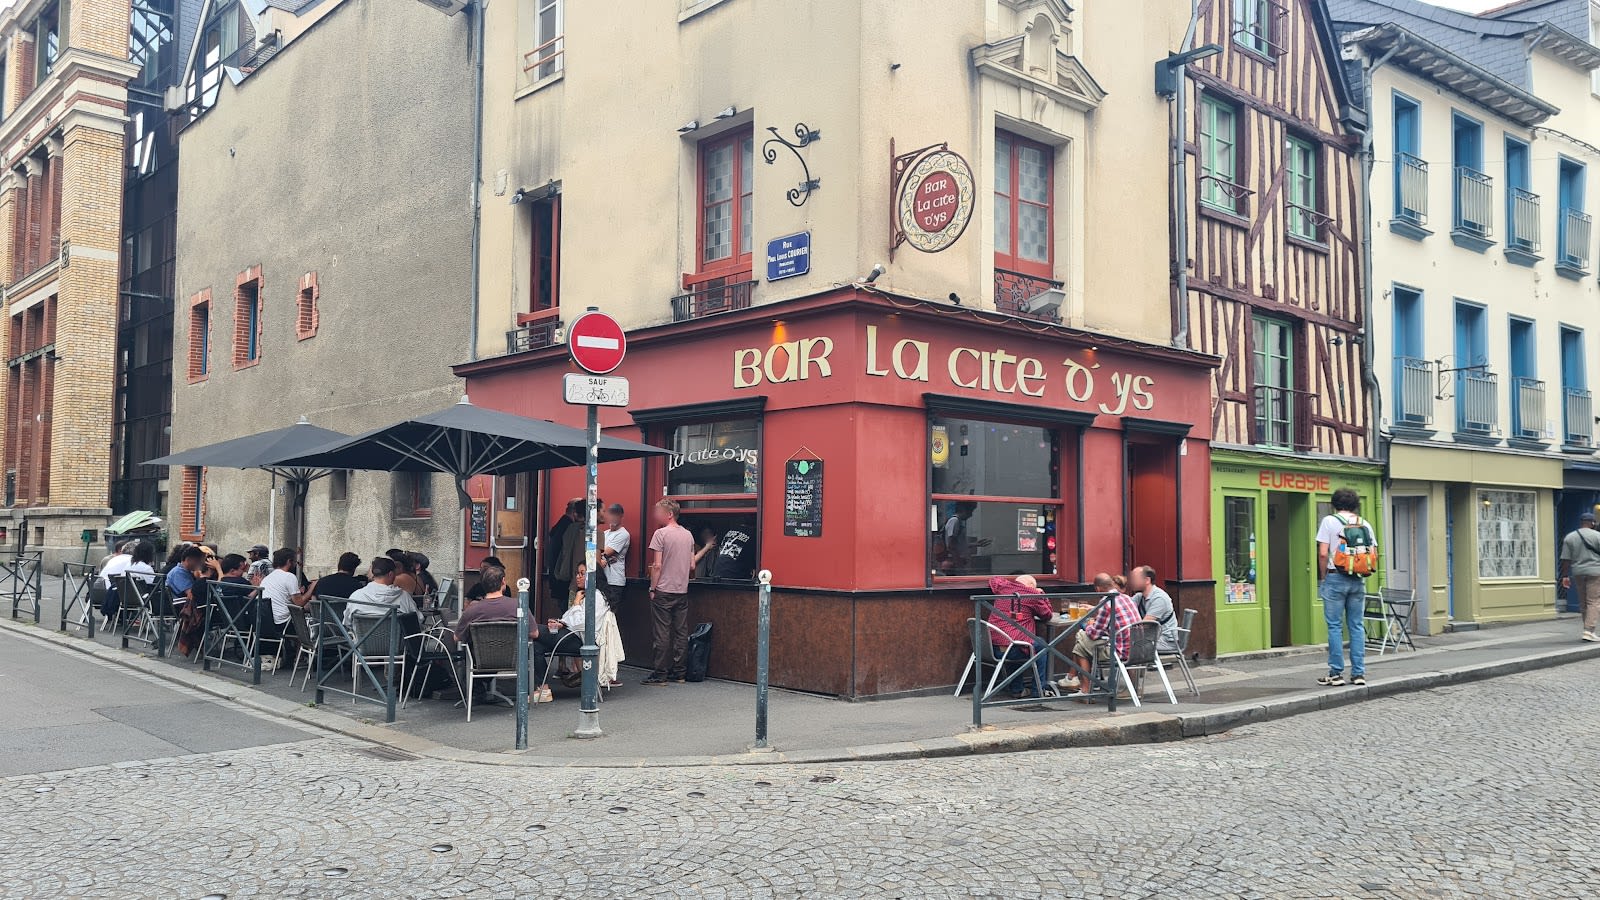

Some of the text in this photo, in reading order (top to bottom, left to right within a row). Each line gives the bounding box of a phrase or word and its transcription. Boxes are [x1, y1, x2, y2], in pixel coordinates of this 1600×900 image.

[788, 247, 807, 258] COURIER
[865, 325, 930, 383] La
[588, 378, 608, 386] SAUF
[1216, 466, 1246, 474] RESTAURANT
